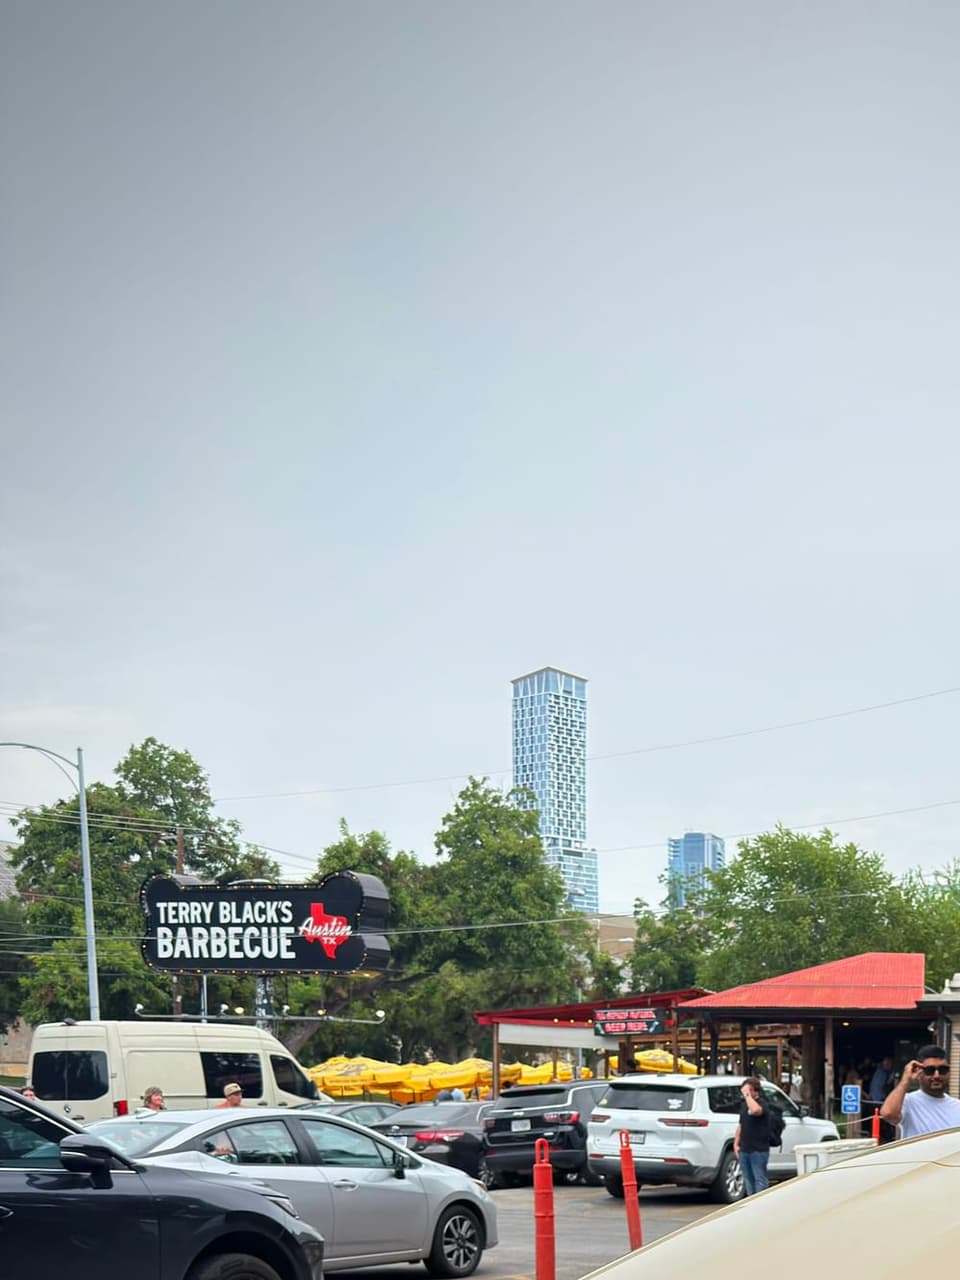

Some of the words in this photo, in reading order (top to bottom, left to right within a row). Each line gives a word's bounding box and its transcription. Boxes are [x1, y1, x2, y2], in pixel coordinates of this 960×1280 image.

[156, 901, 214, 924] TERRY
[219, 901, 293, 924] BLACK'S
[298, 916, 353, 937] Austin
[157, 926, 296, 959] BARBECUE
[322, 937, 337, 945] TX
